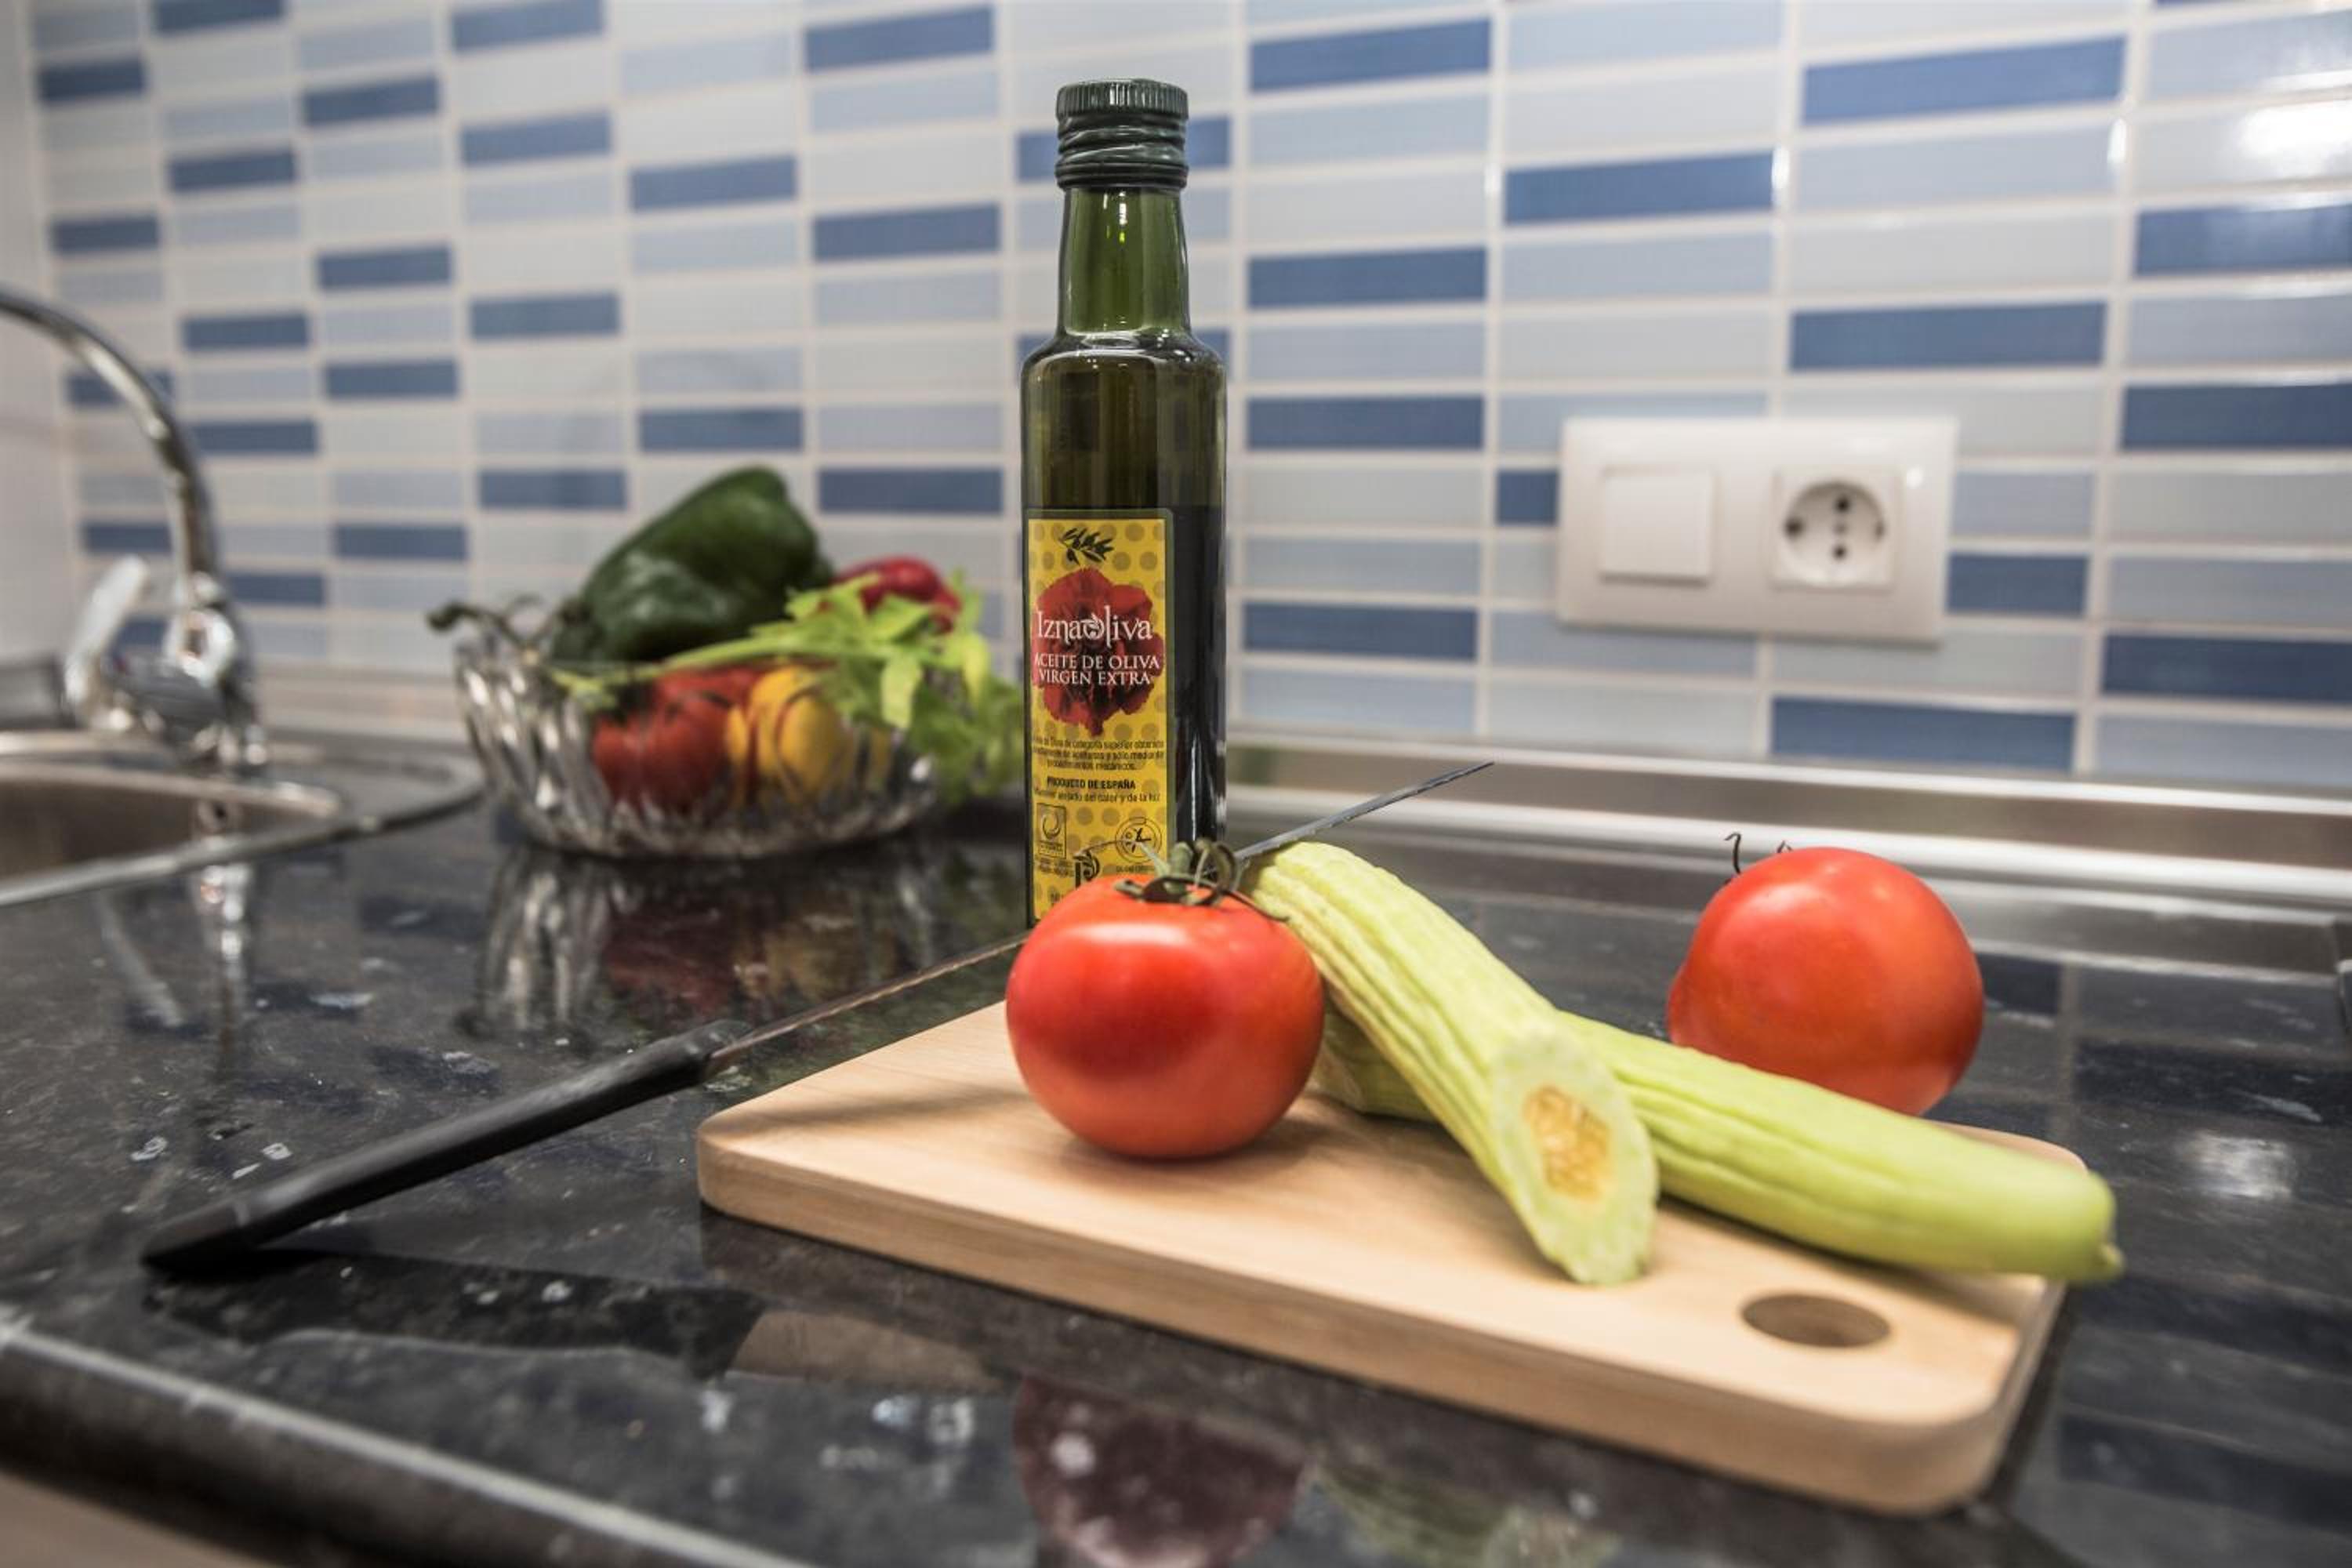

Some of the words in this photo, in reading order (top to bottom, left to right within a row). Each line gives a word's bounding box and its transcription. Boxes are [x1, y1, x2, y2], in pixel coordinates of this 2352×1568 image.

[1035, 652, 1076, 669] ACEITE
[1082, 655, 1104, 669] DE
[1109, 655, 1160, 670] OLIVA
[1040, 670, 1093, 684] VIRGEN
[1098, 671, 1150, 685] EXTRA
[1047, 776, 1086, 789] PRODUCTO
[1088, 779, 1098, 789] DE
[1101, 778, 1136, 789] ESPAÑA
[1127, 792, 1138, 802] de
